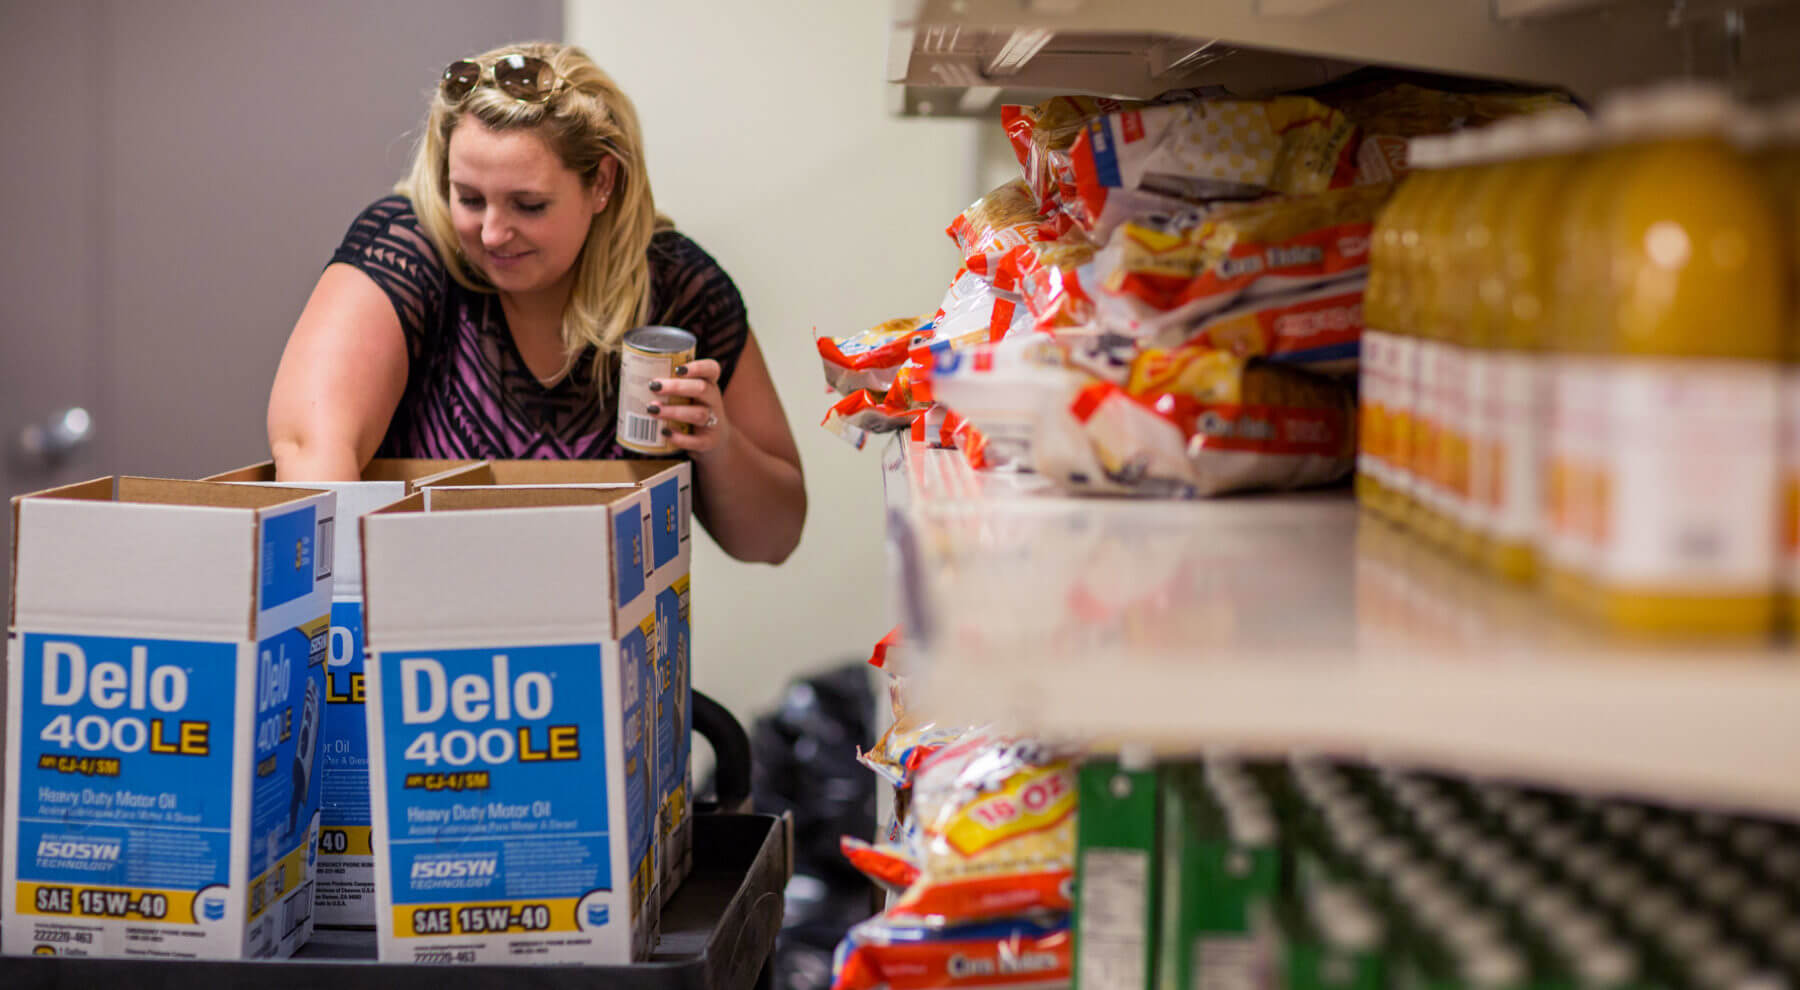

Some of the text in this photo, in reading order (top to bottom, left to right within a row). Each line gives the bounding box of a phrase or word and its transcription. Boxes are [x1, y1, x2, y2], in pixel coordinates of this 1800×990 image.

[41, 641, 188, 712] Delo
[259, 643, 291, 713] Delo
[399, 654, 553, 725] Delo
[38, 787, 176, 809] Heavy Duty Motor Oil
[407, 801, 551, 824] Heavy Duty Motor Oil
[37, 841, 120, 860] ISOSYN
[36, 858, 115, 871] TECHNOLOGY
[410, 860, 496, 878] ISOSYN
[410, 878, 492, 890] TECHNOLOGY
[37, 888, 166, 917] SAE 15W-40
[414, 907, 548, 933] SAE 15W-40
